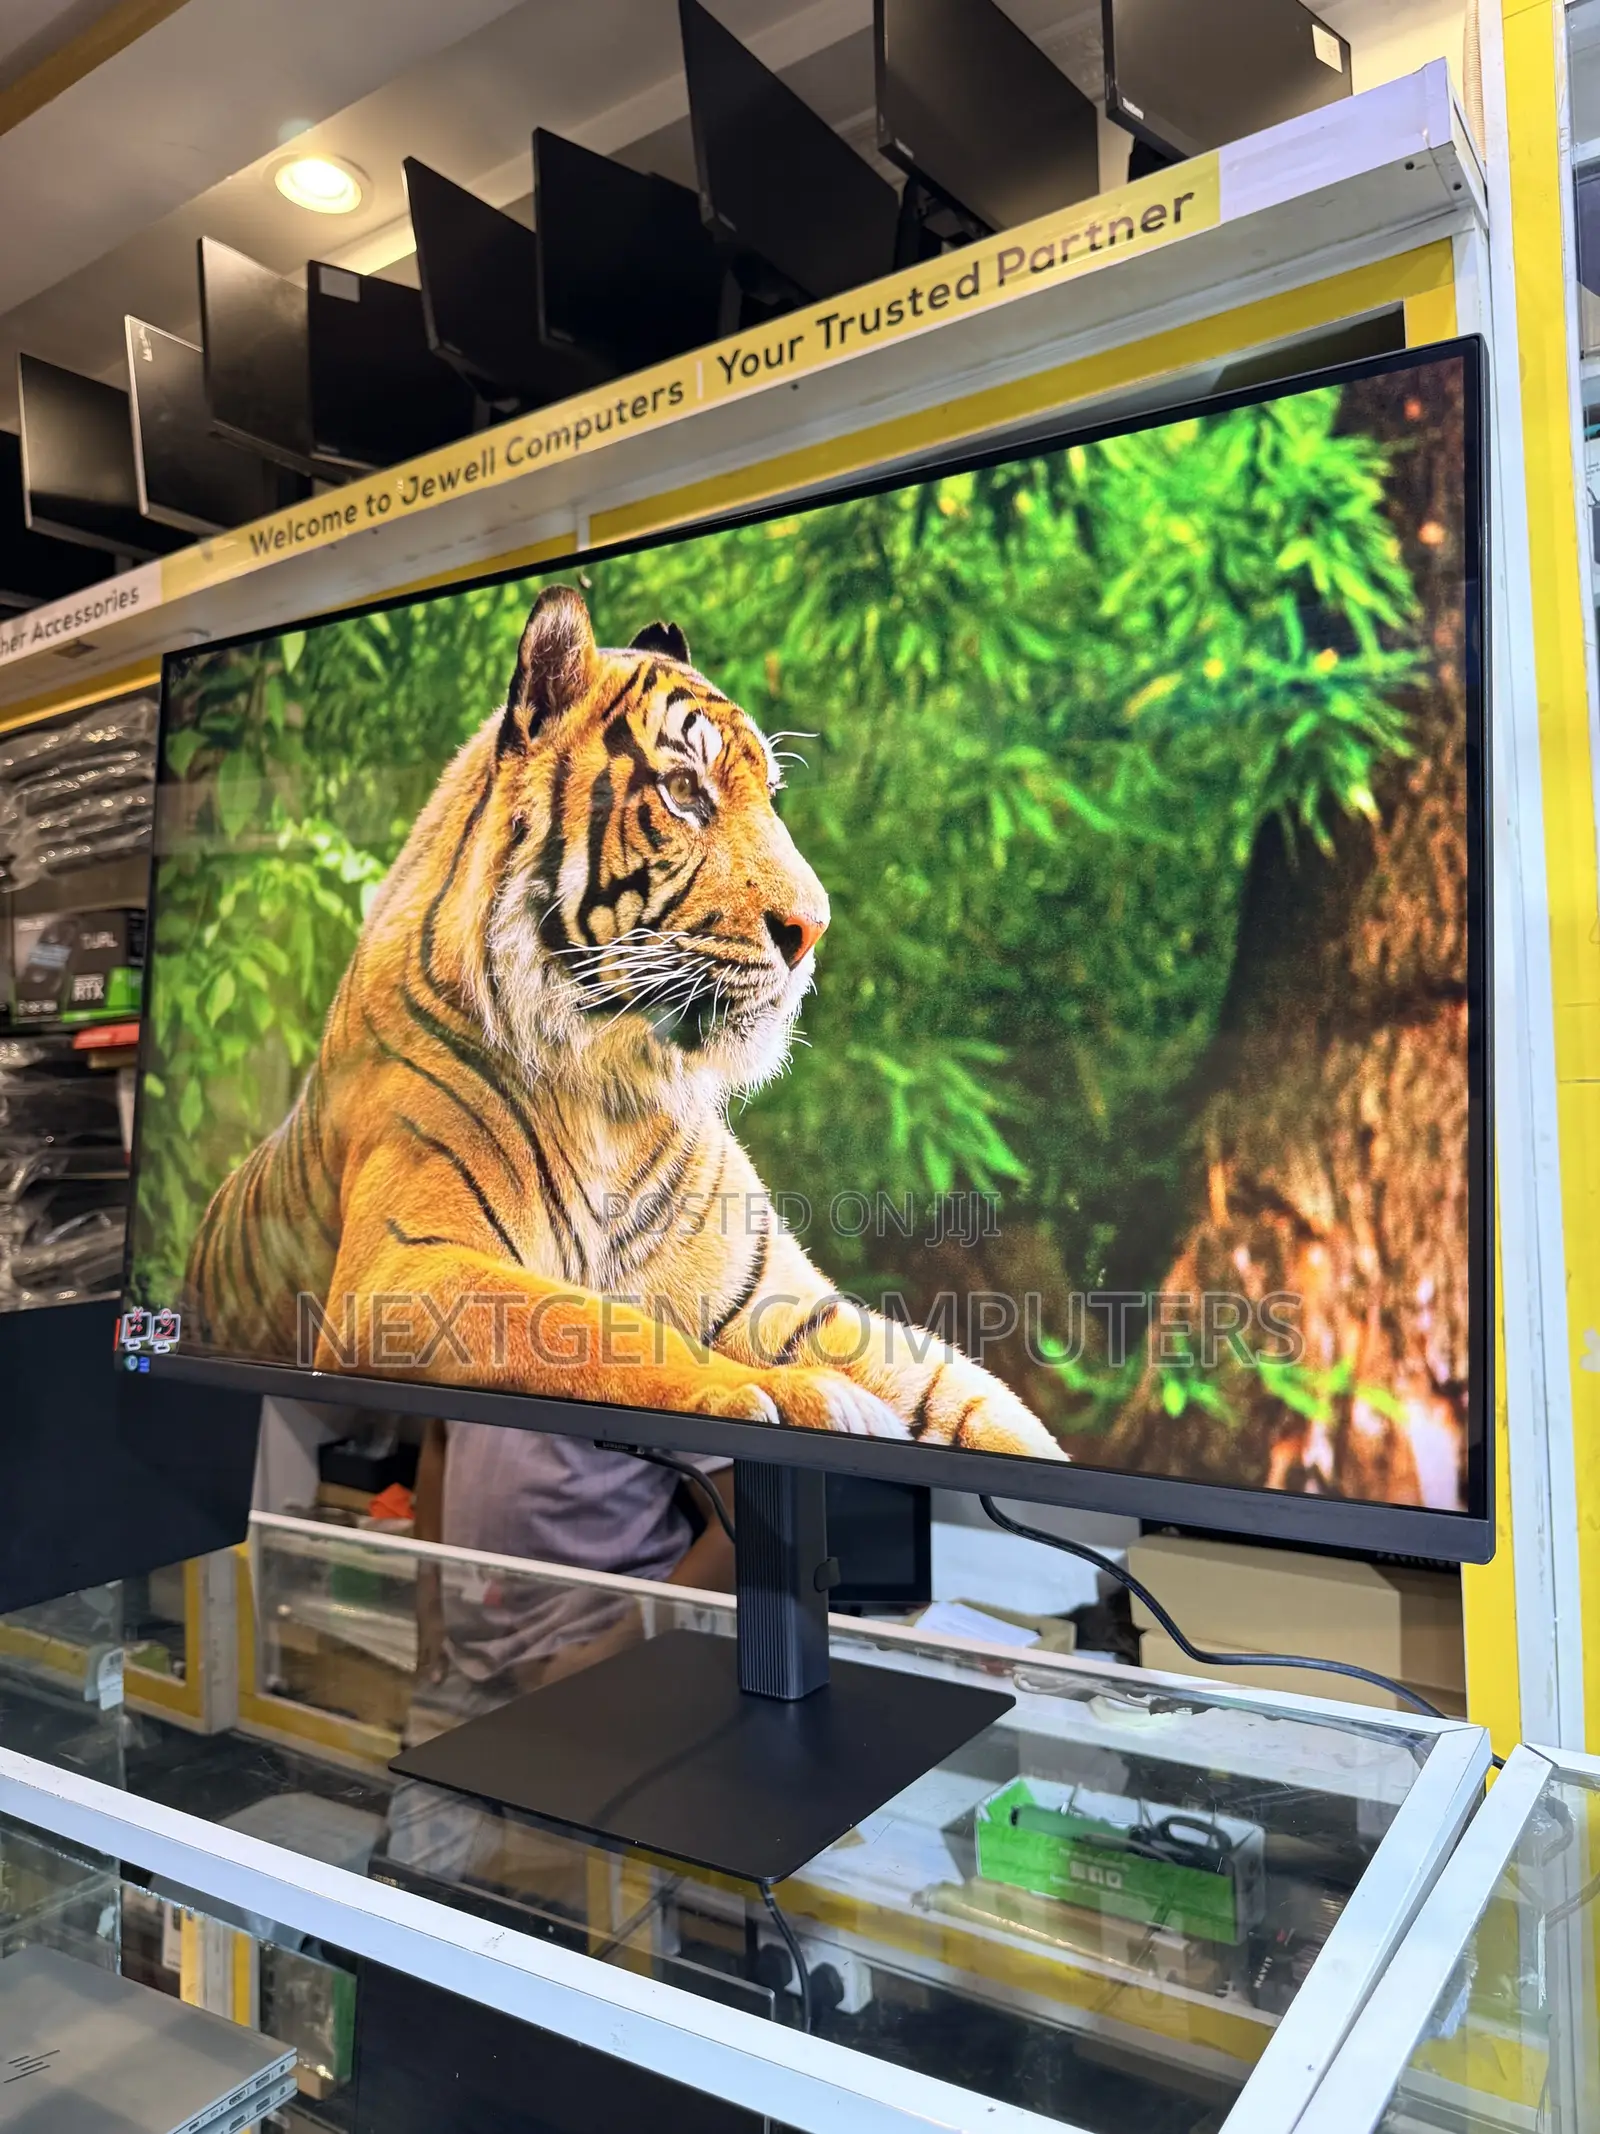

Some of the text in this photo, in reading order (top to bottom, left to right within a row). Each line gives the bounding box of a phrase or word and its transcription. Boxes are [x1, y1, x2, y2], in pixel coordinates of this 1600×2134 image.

[249, 190, 1195, 557] Welcome to Jewell Computers Your Trusted Partner
[31, 586, 140, 644] Accessories
[72, 983, 105, 1001] RTX
